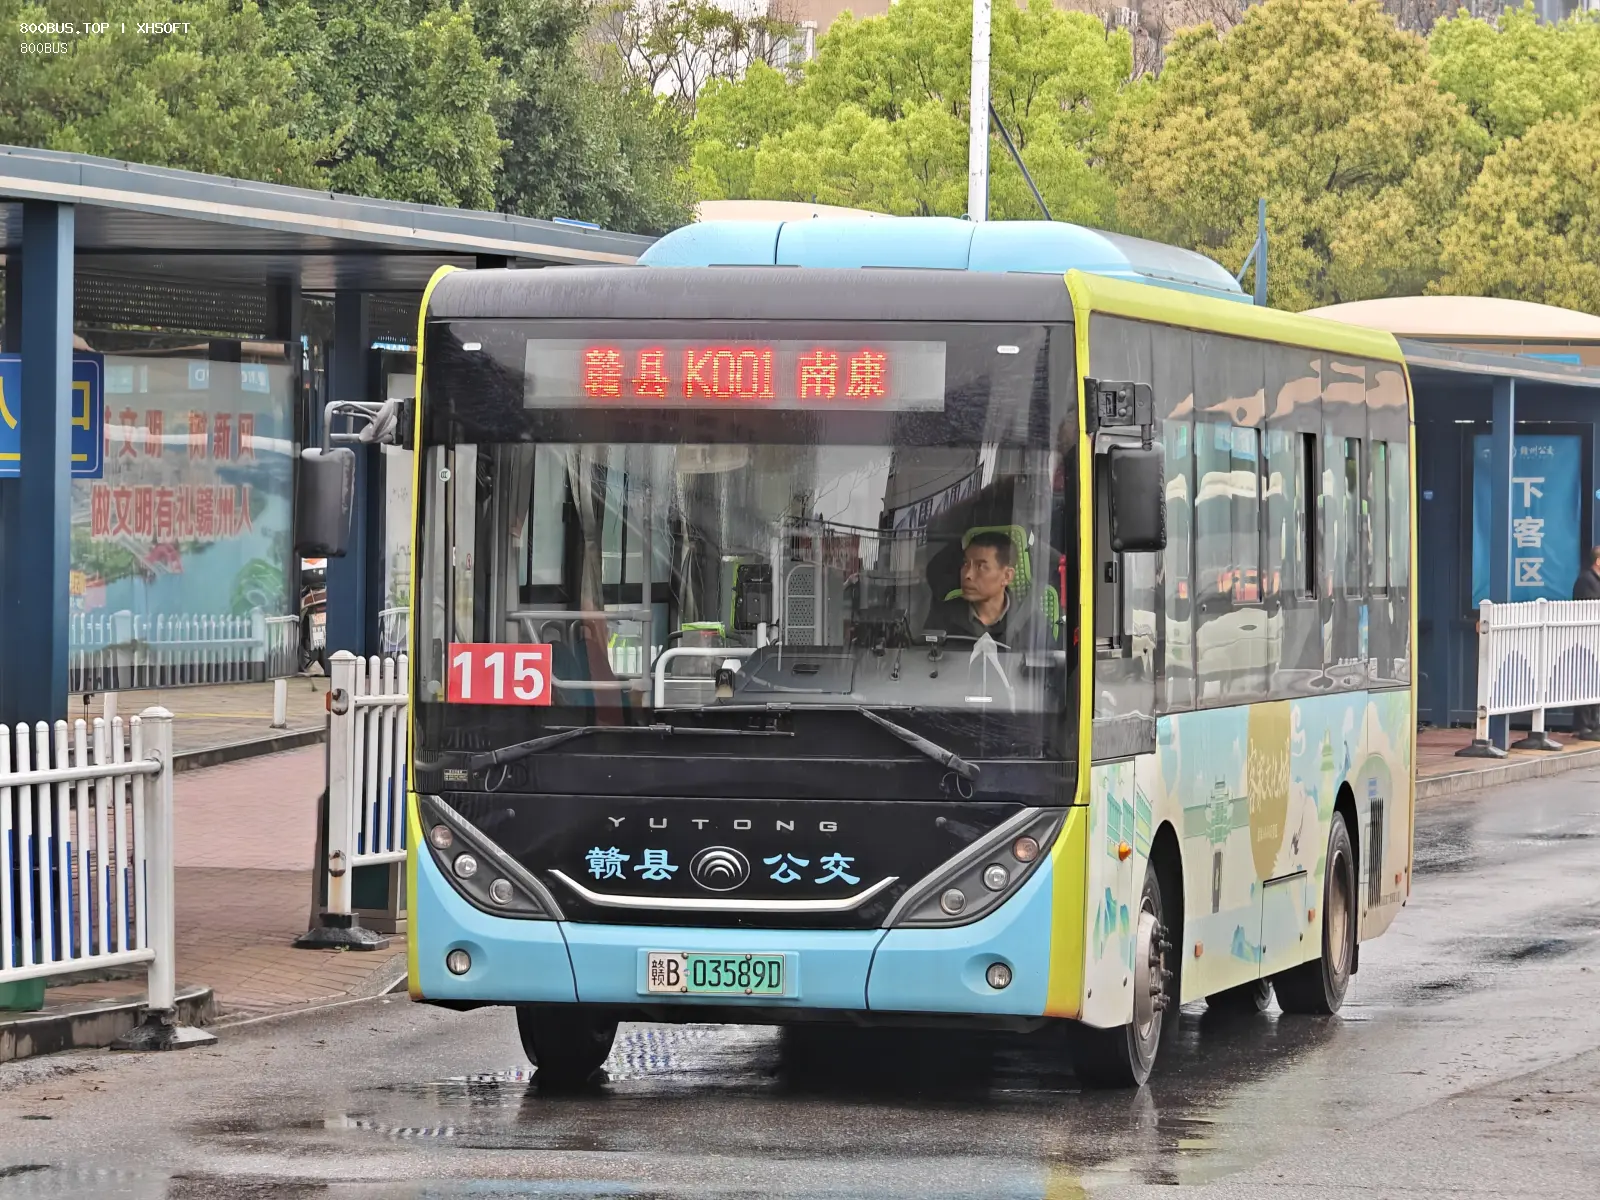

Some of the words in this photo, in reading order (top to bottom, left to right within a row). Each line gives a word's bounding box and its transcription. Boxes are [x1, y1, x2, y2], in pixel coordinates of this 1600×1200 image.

[685, 350, 775, 398] K001
[798, 351, 887, 398] 南康
[104, 405, 164, 459] 文明
[91, 483, 253, 539] 做文明有礼赣州人
[1511, 476, 1545, 587] 下客区
[453, 652, 544, 700] 115
[608, 816, 838, 832] YUTONG
[585, 846, 679, 881] 赣县
[763, 852, 861, 885] 公交
[651, 958, 680, 987] 赣B
[693, 958, 781, 989] 03589D
